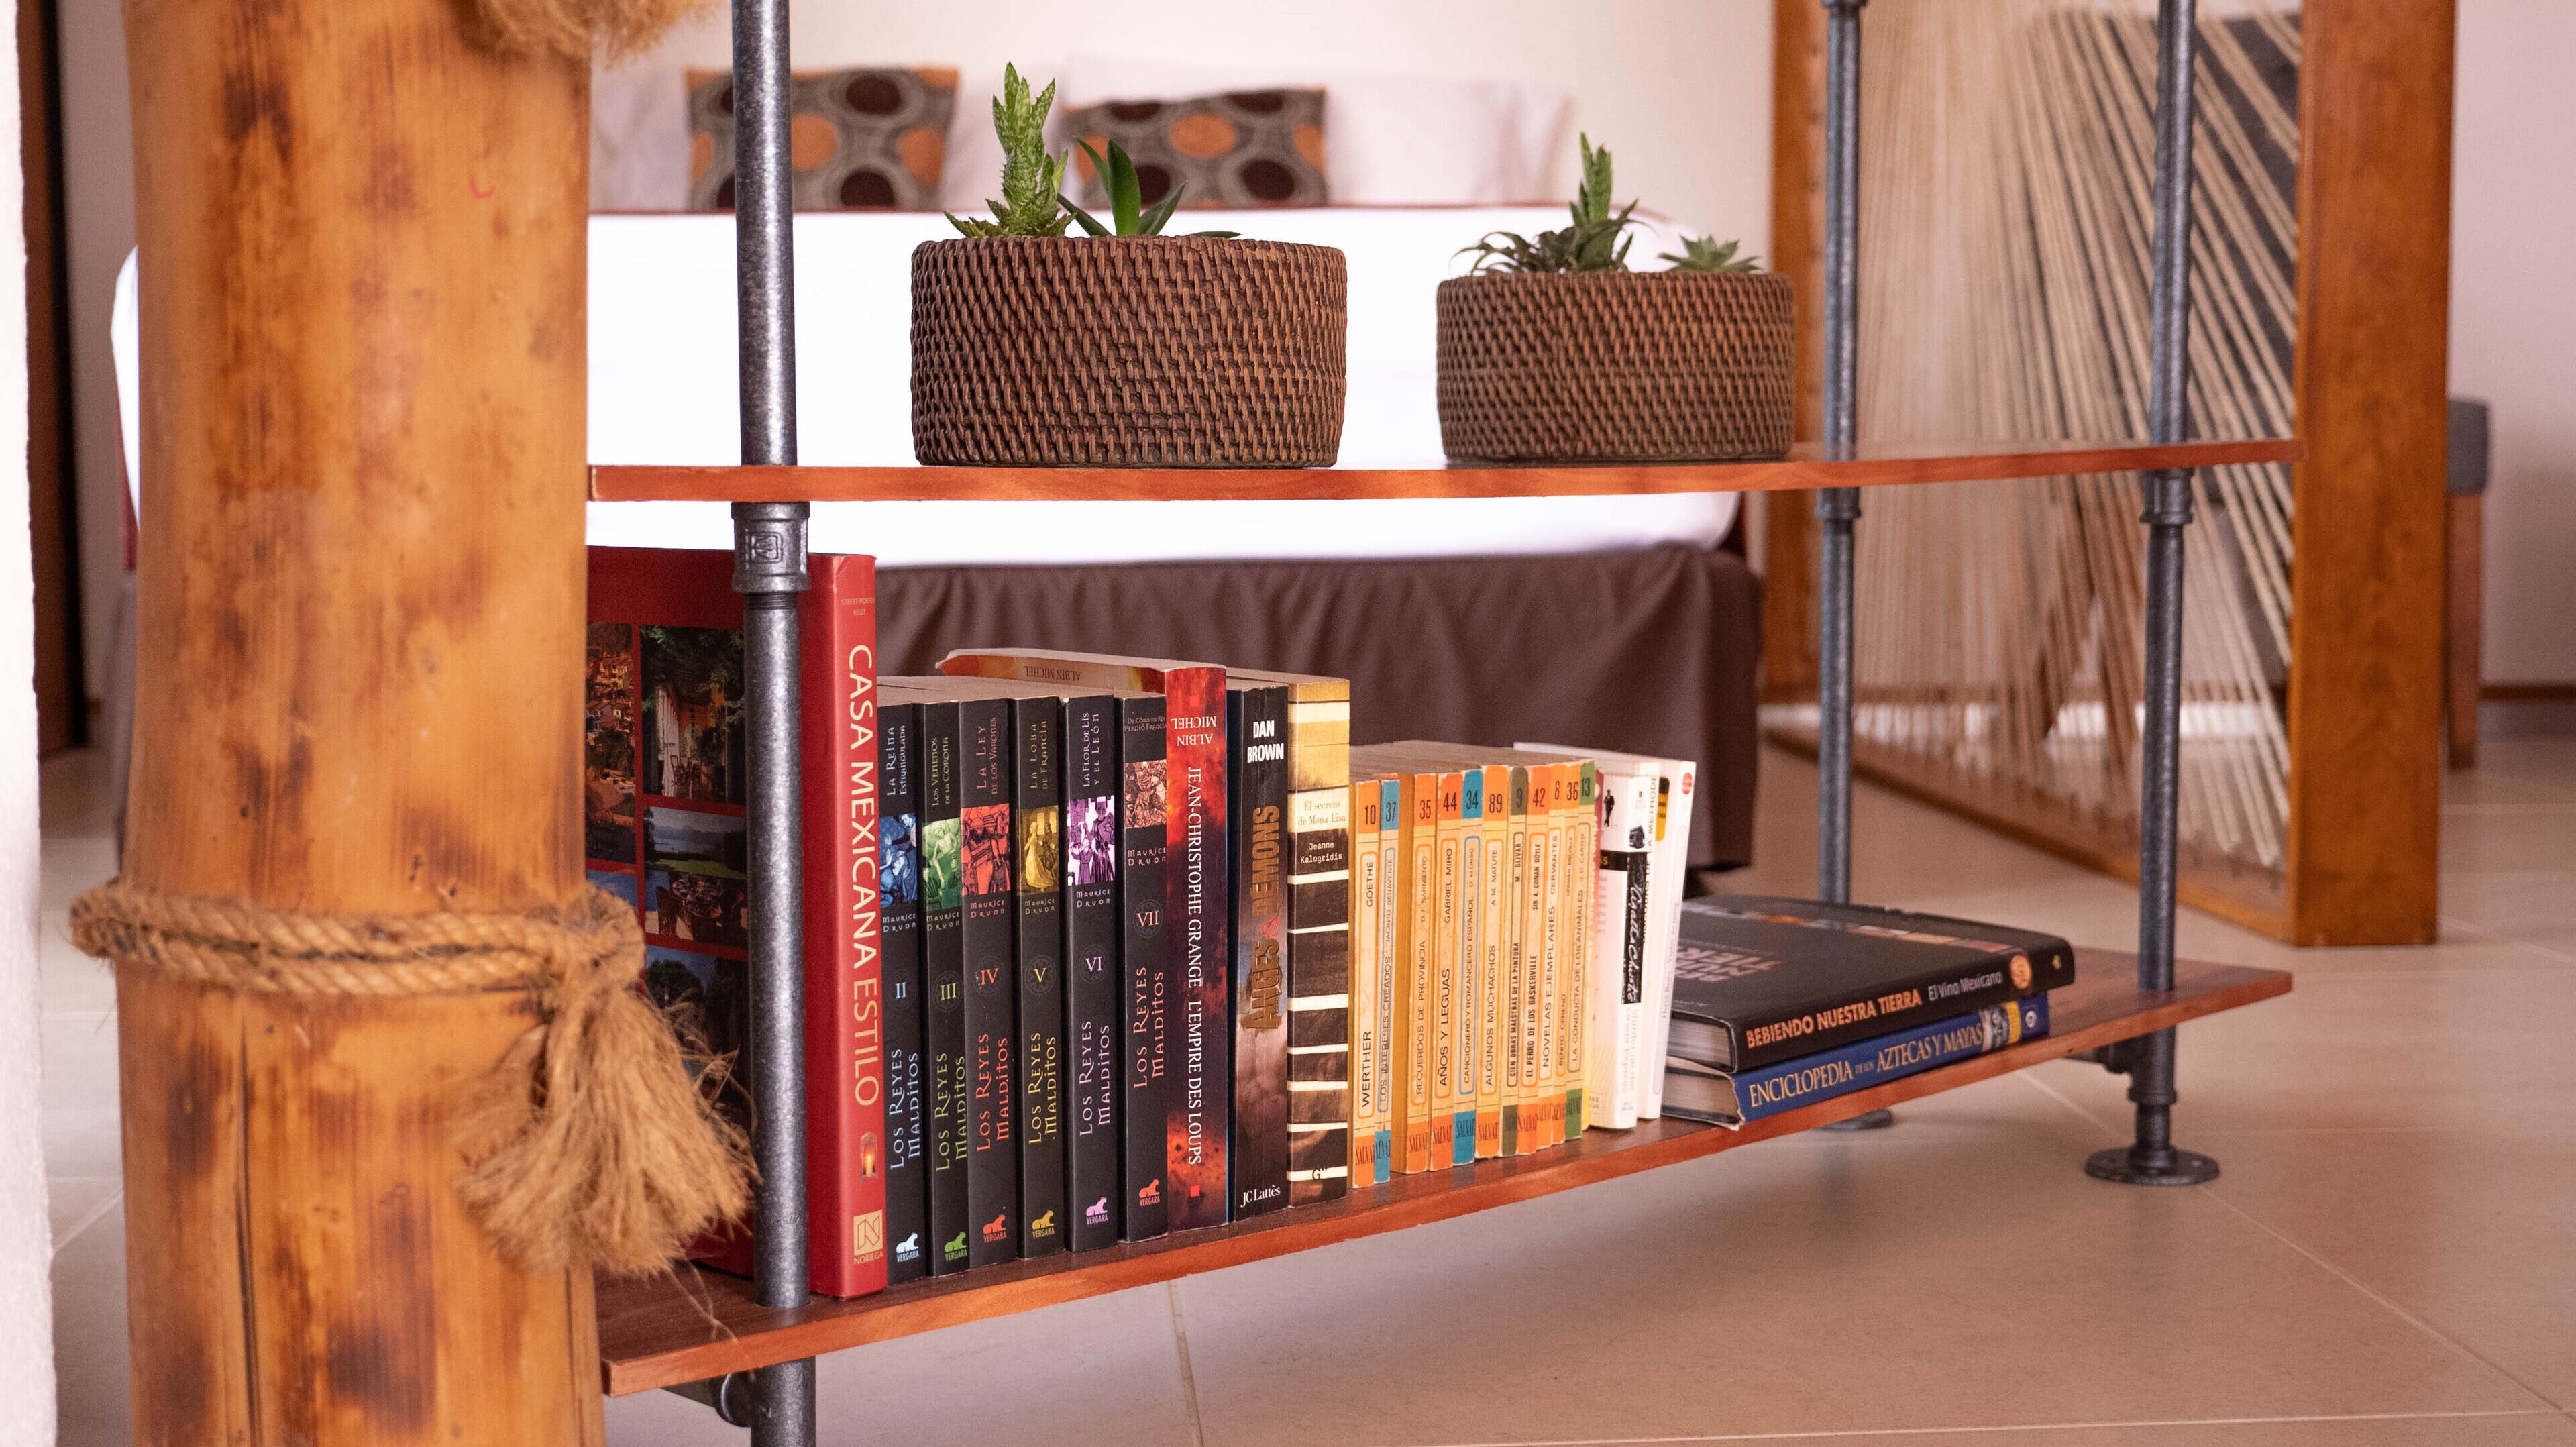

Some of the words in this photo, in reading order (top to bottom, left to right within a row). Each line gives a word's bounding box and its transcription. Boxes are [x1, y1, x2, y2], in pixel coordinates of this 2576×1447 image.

[1024, 665, 1056, 679] MICHEL
[1056, 670, 1082, 682] ALBIN
[849, 644, 873, 749] CASA
[1171, 716, 1217, 729] MICHEL
[1253, 720, 1275, 738] DAN
[976, 725, 986, 756] LEY
[1091, 714, 1099, 753] LEÓN
[1177, 733, 1214, 746] ALBIN
[1247, 743, 1284, 763] BROWN
[1093, 761, 1099, 772] EL
[887, 778, 896, 796] LA
[977, 767, 987, 789] LA
[1030, 771, 1037, 789] LA
[1083, 773, 1090, 787] LA
[1581, 777, 1591, 797] 13
[1466, 790, 1479, 810] 34
[1533, 788, 1546, 807] 42
[1555, 780, 1560, 800] 8
[1567, 782, 1578, 801] 36
[1305, 801, 1311, 810] El
[1386, 802, 1396, 822] 37
[1420, 800, 1431, 819] 35
[1443, 792, 1457, 812] 44
[1489, 794, 1503, 813] 89
[1298, 818, 1306, 826] de
[1309, 815, 1328, 825] Mona
[1331, 813, 1346, 822] Lisa
[1365, 805, 1376, 825] 10
[1187, 767, 1201, 915] JEAN-CHRISTOPHE
[1309, 842, 1334, 851] Jeanne
[851, 761, 877, 969] MEXICANA
[1300, 853, 1342, 864] Kalogridis
[1136, 910, 1159, 927] VII
[1545, 906, 1555, 997] EJEMPLARES
[1085, 957, 1102, 972] VI
[981, 967, 998, 985] IV
[1034, 967, 1046, 983] V
[1243, 939, 1280, 1029] ANGES
[1487, 945, 1495, 1022] MUCHACHOS
[1512, 975, 1518, 985] LA
[1529, 955, 1537, 1006] BASKERVILLE
[896, 982, 907, 998] II
[940, 982, 957, 1001] III
[1441, 969, 1450, 1024] LEGUAS
[1512, 986, 1518, 994] DE
[1133, 967, 1149, 1034] REYES
[1746, 1015, 1815, 1049] BEBIENDO
[1816, 1000, 1877, 1030] NUESTRA
[1878, 989, 1922, 1014] TIERRA
[1928, 984, 1939, 1001] El
[1939, 980, 1958, 998] Vino
[1960, 971, 2003, 992] Mexicano
[1418, 1007, 1424, 1020] DE
[1152, 972, 1164, 1079] MALDITOS
[1440, 1031, 1448, 1040] Y
[1528, 1027, 1535, 1036] DE
[1543, 1002, 1551, 1068] NOVELAS
[853, 977, 879, 1106] ESTILO
[1188, 1001, 1201, 1074] L'EMPIRE
[1079, 1021, 1094, 1084] REYES
[1485, 1028, 1493, 1085] ALGUNOS
[975, 1034, 992, 1100] REYES
[1028, 1032, 1043, 1095] REYES
[1134, 1047, 1147, 1088] LOS
[1362, 1031, 1371, 1107] WERTHER
[1438, 1046, 1448, 1086] AÑOS
[1526, 1069, 1533, 1077] EL
[1749, 1061, 1854, 1107] ENCICLOPEDIA
[1876, 1037, 1932, 1072] AZTECAS
[1931, 1034, 1941, 1056] Y
[1943, 1023, 1984, 1053] MAYAS
[889, 1049, 905, 1116] REYES
[1044, 1036, 1057, 1135] MALDITOS
[1098, 1025, 1110, 1126] MALDITOS
[935, 1053, 950, 1119] REYES
[996, 1038, 1009, 1141] MALDITOS
[1188, 1077, 1201, 1109] DES
[906, 1053, 920, 1159] MALDITOS
[954, 1056, 967, 1161] MALDITOS
[1080, 1096, 1092, 1136] LOS
[977, 1110, 990, 1152] LOS
[1029, 1105, 1042, 1144] LOS
[890, 1126, 905, 1169] LOS
[1188, 1114, 1201, 1165] LOUPS
[936, 1130, 949, 1172] LOS
[1140, 1195, 1160, 1206] VERGARA
[1241, 1190, 1252, 1208] JC
[1254, 1185, 1281, 1201] Lattès
[1087, 1214, 1108, 1225] VERGARA
[983, 1232, 1006, 1242] VERGARA
[1032, 1226, 1055, 1238] VERGARA
[854, 1250, 883, 1264] NORIEGA
[896, 1250, 919, 1263] VERGARA
[945, 1249, 967, 1262] VERGARA
